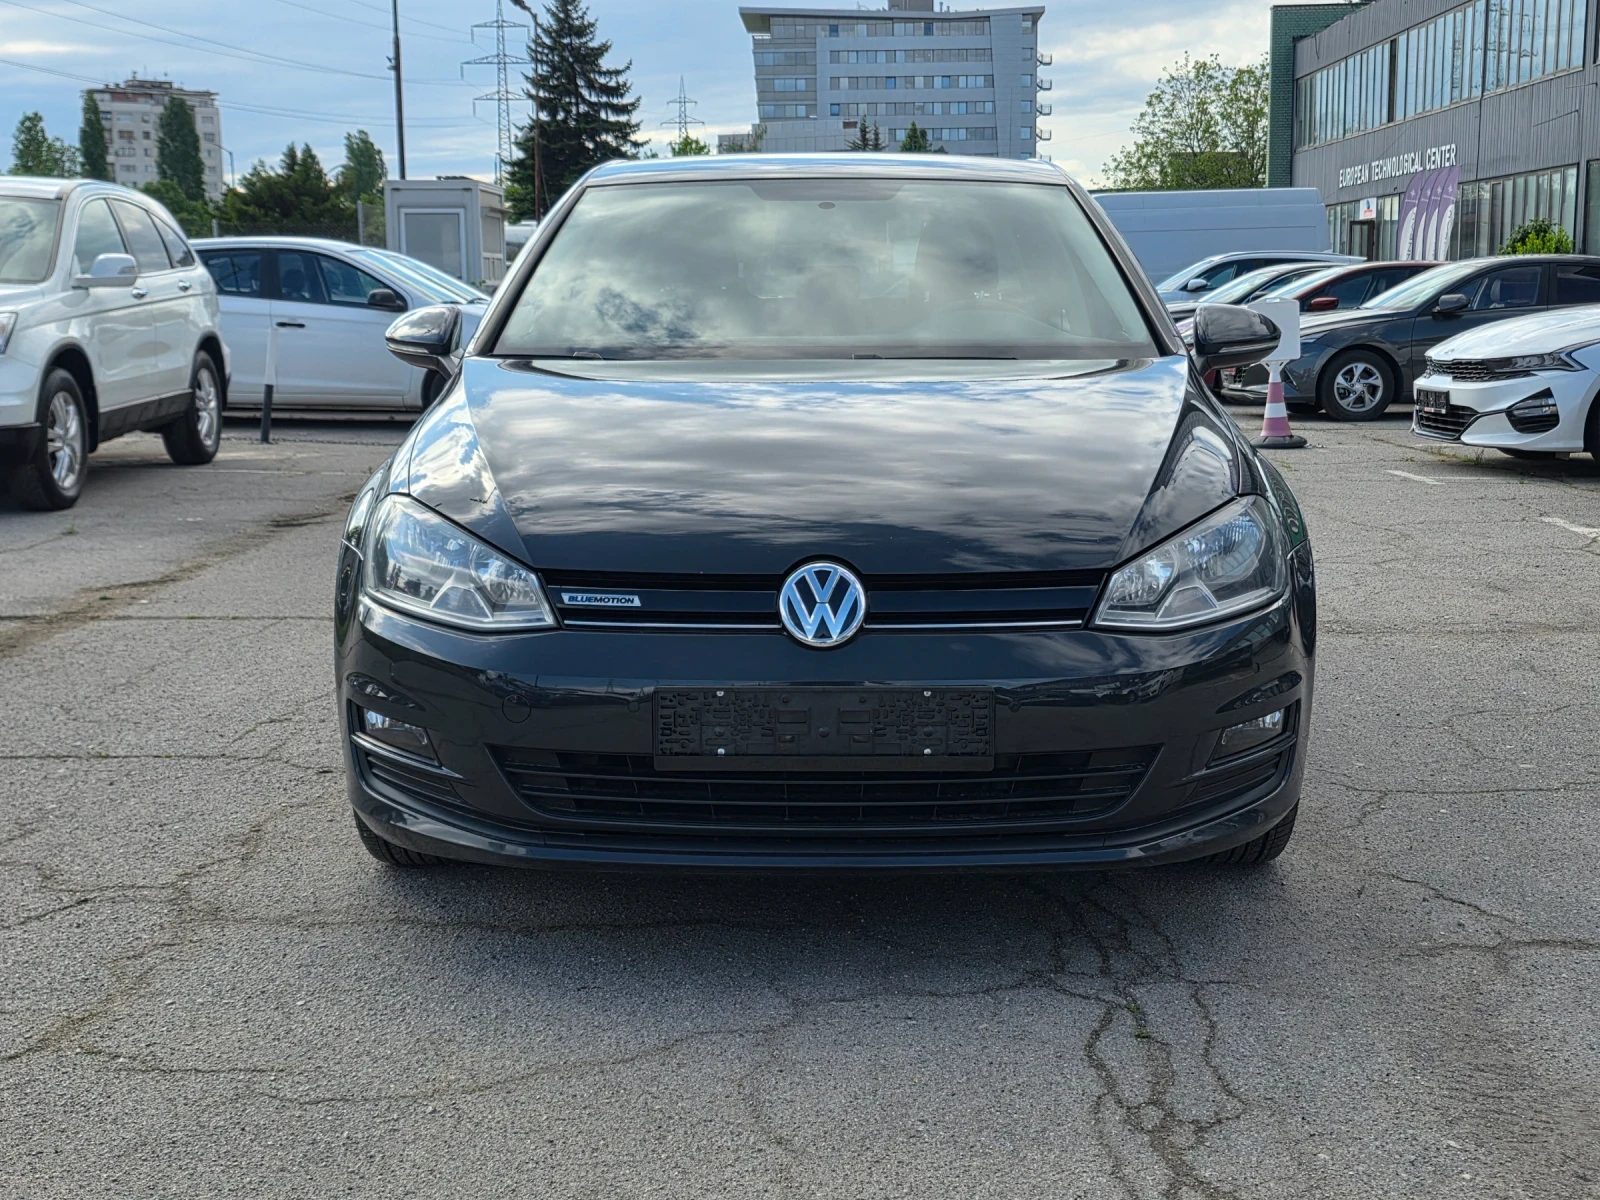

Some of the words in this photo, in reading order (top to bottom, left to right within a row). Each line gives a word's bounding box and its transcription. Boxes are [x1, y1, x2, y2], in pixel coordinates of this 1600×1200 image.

[1339, 163, 1369, 188] EUROPEAN
[1371, 151, 1423, 181] TECHNOLOGICAL
[1426, 144, 1456, 170] CENTER
[567, 595, 635, 605] BLUEMOTION
[784, 567, 861, 641] VW
